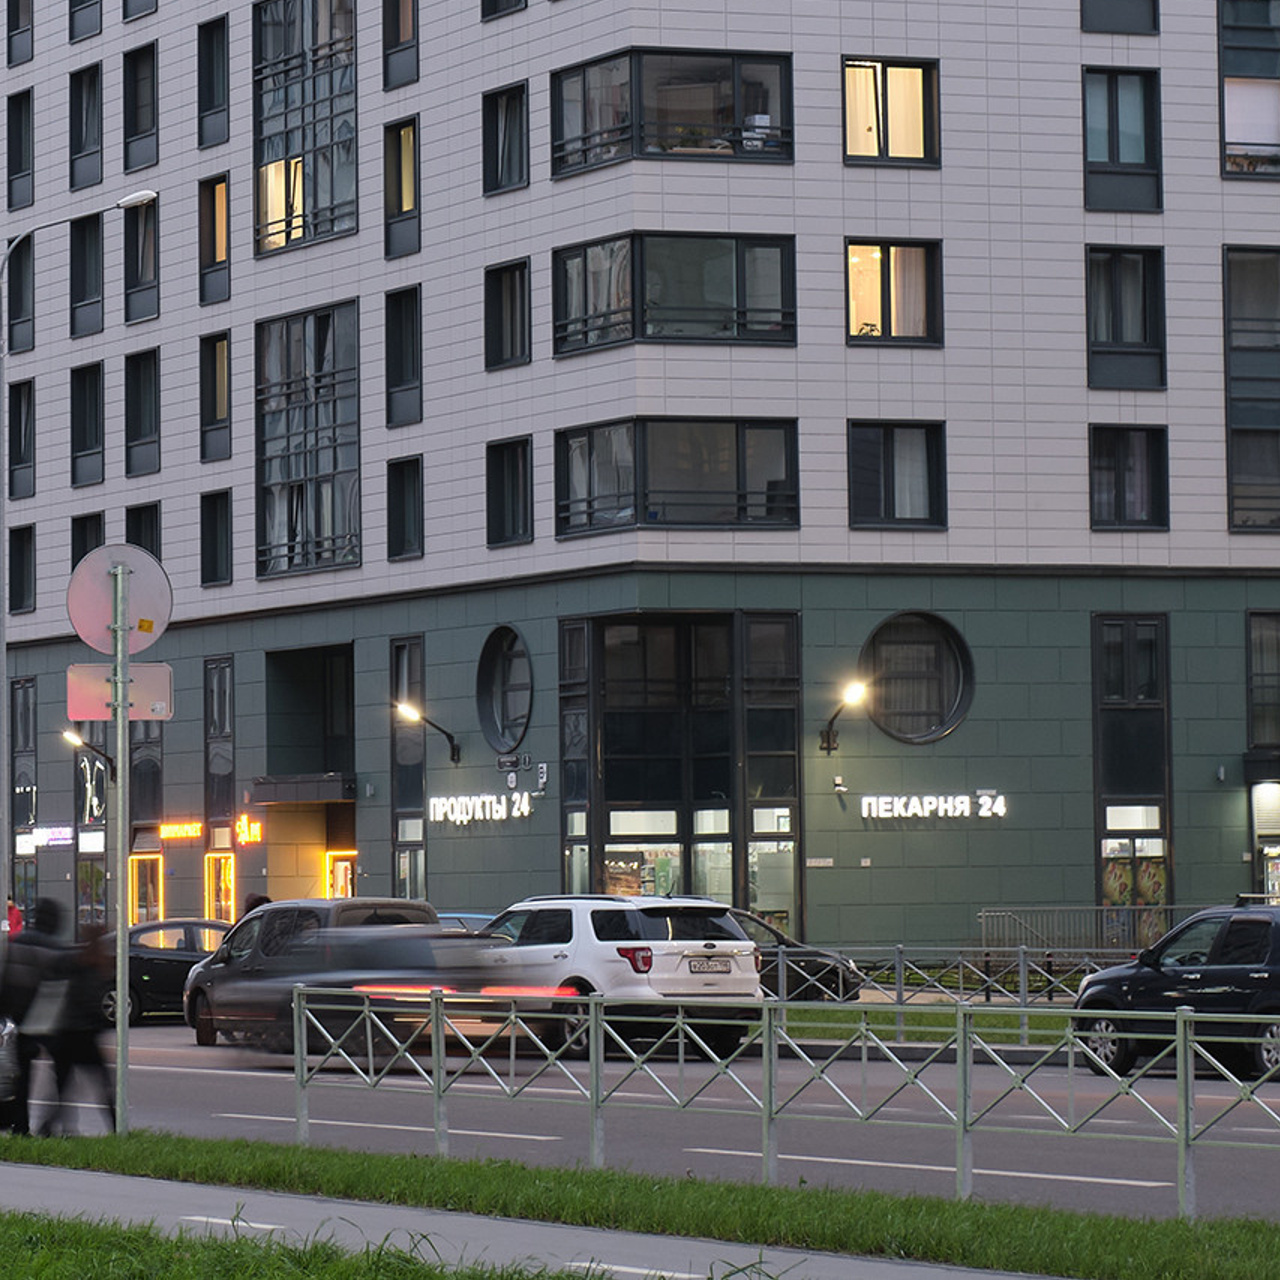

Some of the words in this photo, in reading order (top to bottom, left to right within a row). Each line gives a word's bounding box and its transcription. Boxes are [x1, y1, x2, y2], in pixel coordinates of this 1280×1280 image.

[428, 794, 508, 825] ПРОДУКТЫ
[510, 791, 531, 817] 24
[860, 795, 971, 818] ПЕКАРНЯ
[977, 795, 1007, 817] 24
